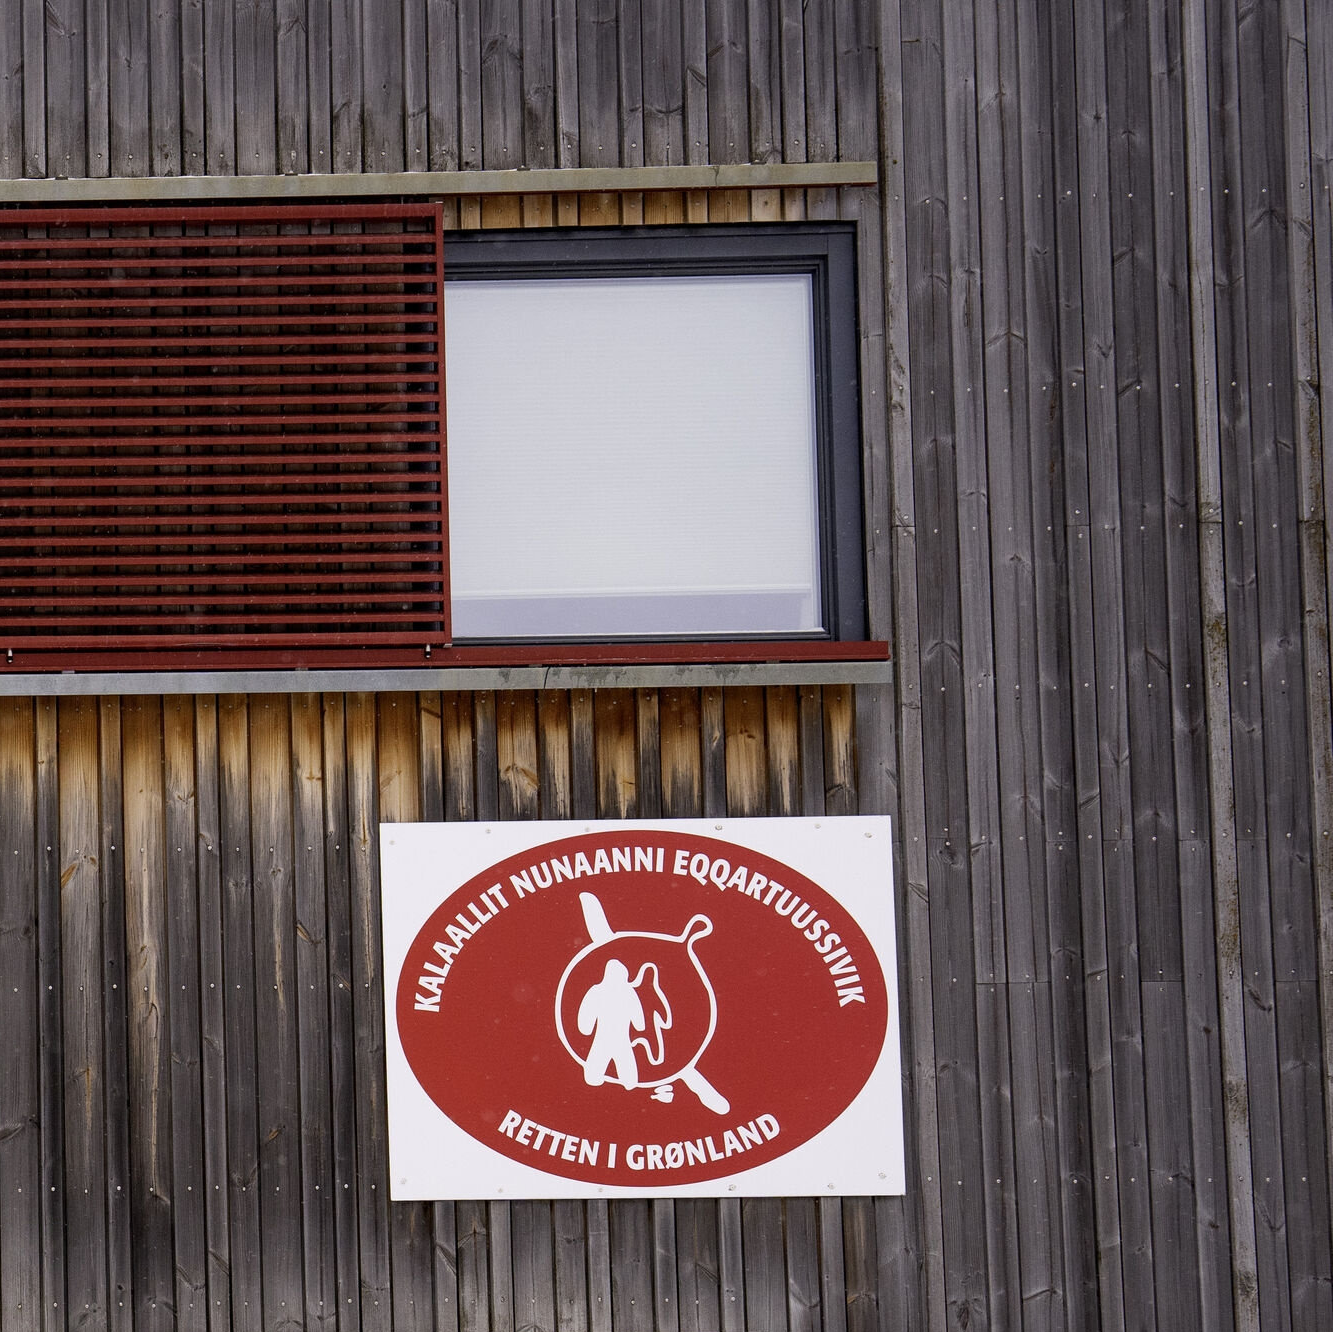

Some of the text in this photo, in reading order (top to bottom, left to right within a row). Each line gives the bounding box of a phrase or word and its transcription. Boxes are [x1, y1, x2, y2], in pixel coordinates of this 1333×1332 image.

[414, 846, 866, 1013] KALAALLIT NUNAANNI EQQARTUUSSIVIK
[497, 1109, 781, 1171] RETTEN I GRØNLAND
